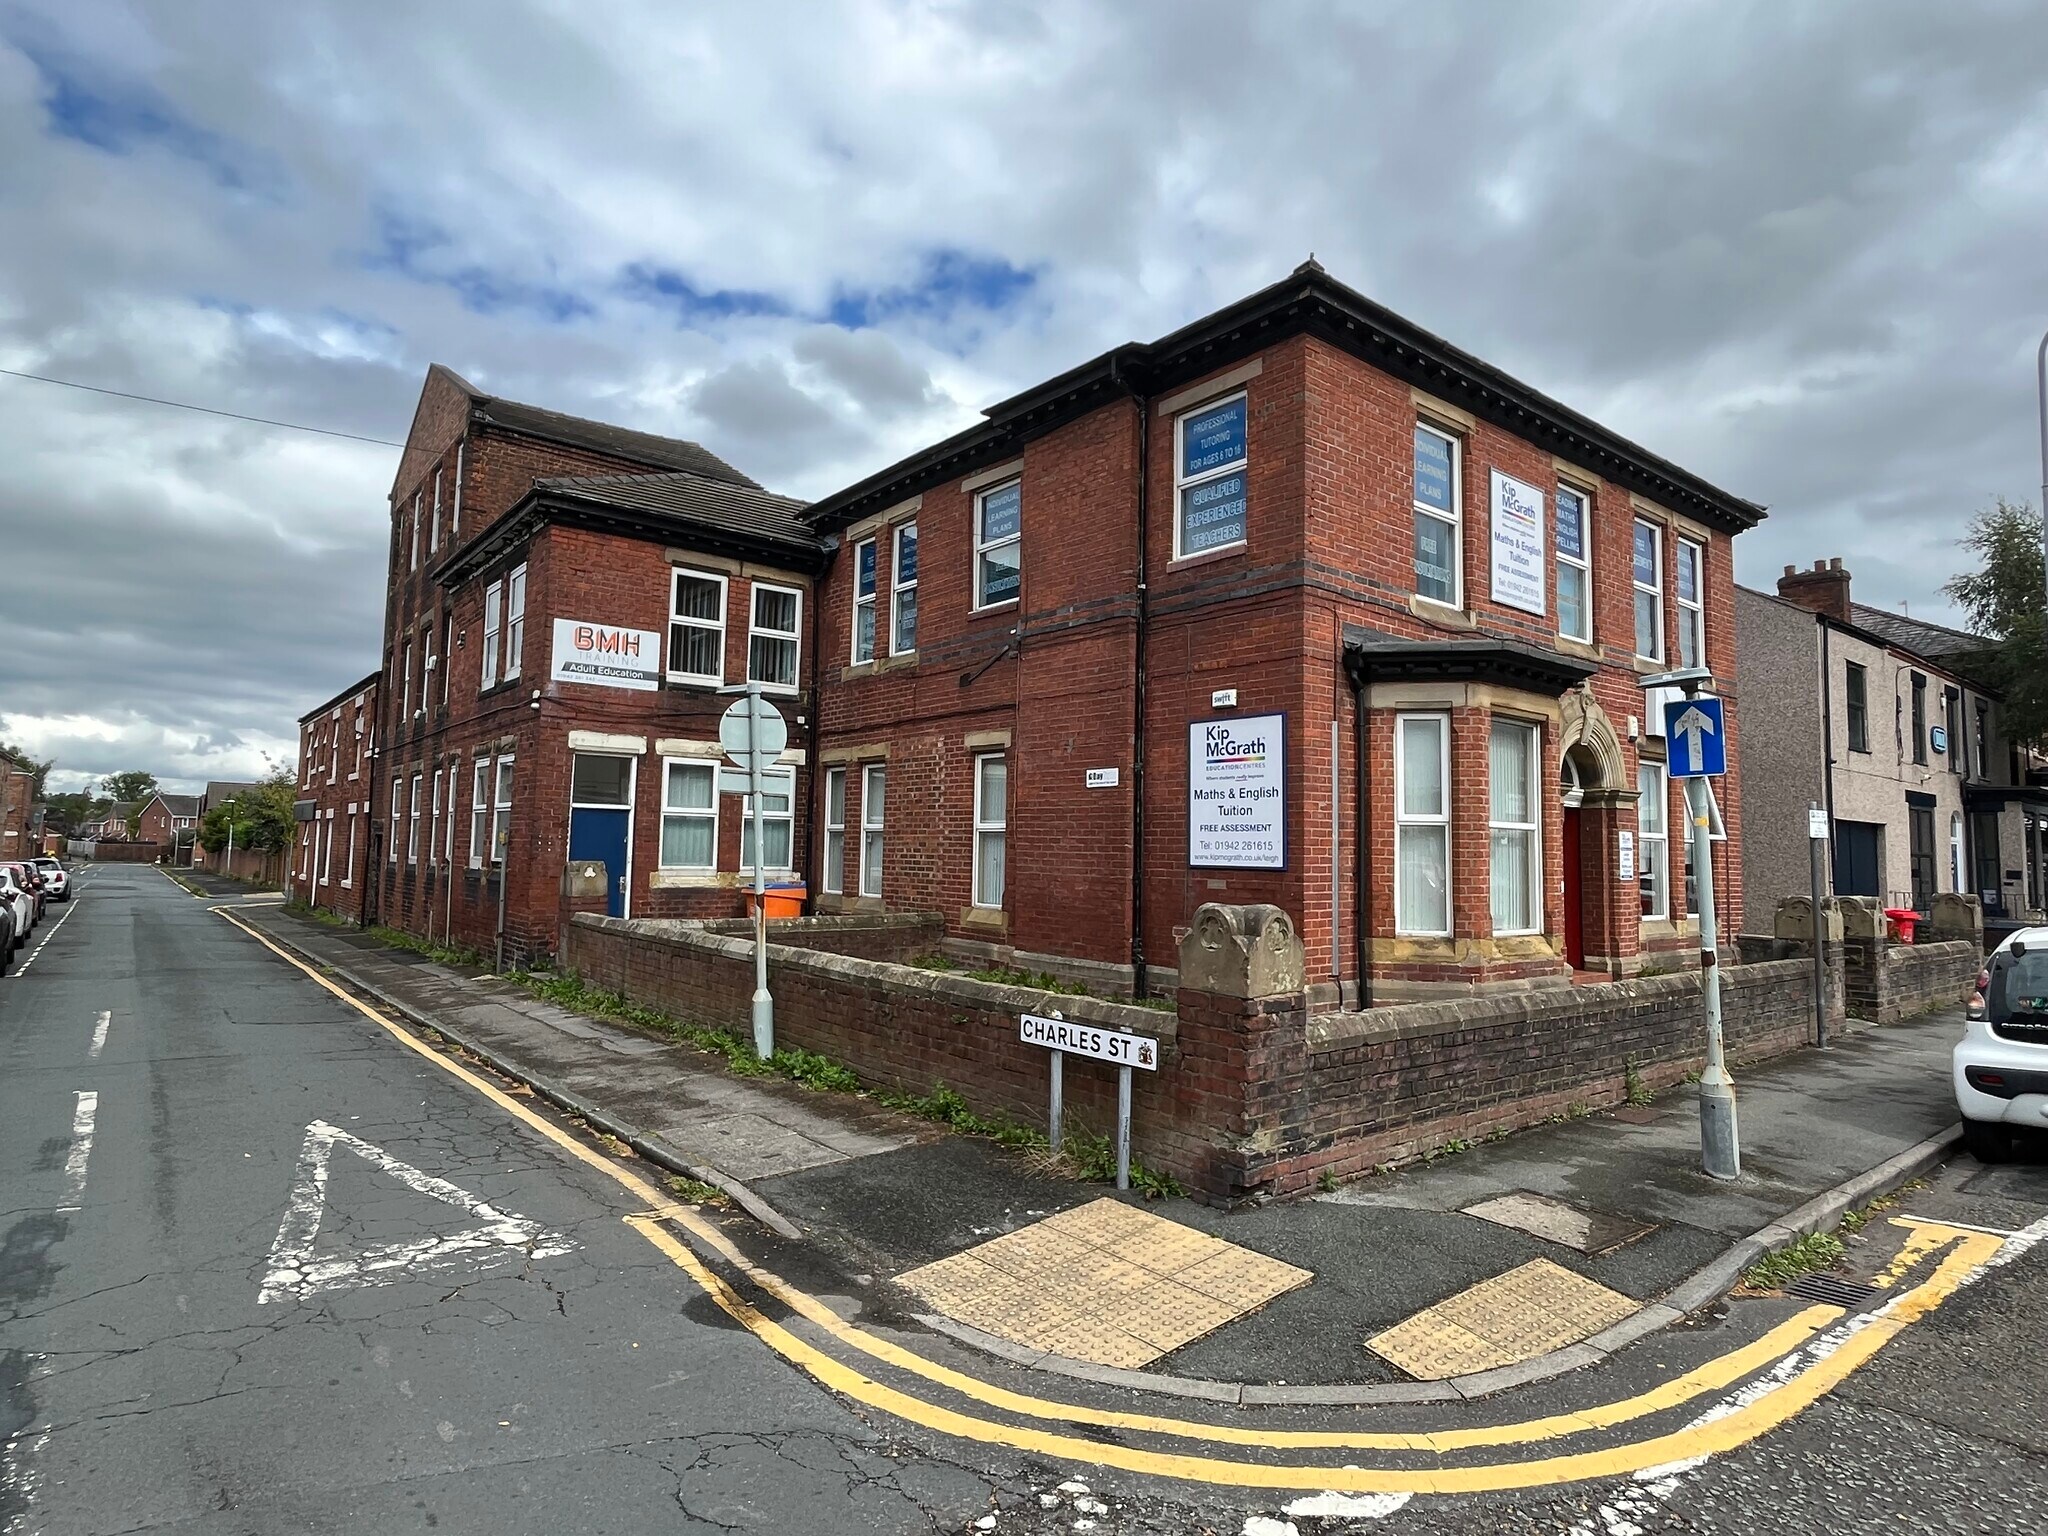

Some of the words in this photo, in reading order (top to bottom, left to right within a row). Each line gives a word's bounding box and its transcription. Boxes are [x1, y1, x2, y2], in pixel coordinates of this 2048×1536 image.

[1193, 410, 1238, 435] PROFESSIONAL
[1200, 430, 1231, 449] TUTORING
[1190, 458, 1202, 470] FOR
[1203, 451, 1219, 466] AGES
[1225, 447, 1234, 458] TO
[1192, 478, 1241, 506] QUALIFIED
[1502, 479, 1516, 501] Kip
[1185, 498, 1247, 529] EXPERIENCED
[1502, 494, 1535, 519] McGrath
[992, 521, 1013, 535] PLANS
[1191, 522, 1241, 549] TEACHERS
[1494, 531, 1515, 547] Maths
[1516, 539, 1521, 549] &
[1521, 541, 1542, 558] English
[1509, 551, 1530, 567] Tuition
[574, 626, 641, 658] BMH
[579, 652, 639, 668] TRAINING
[569, 663, 596, 674] Adult
[597, 667, 644, 679] Education
[1206, 725, 1230, 746] Kip
[1206, 737, 1266, 757] McGrath
[1194, 789, 1225, 800] Maths
[1228, 788, 1236, 799] &
[1239, 786, 1279, 801] English
[1218, 805, 1253, 816] Tuition
[1200, 824, 1219, 832] FREE
[1220, 823, 1272, 832] ASSESSMENT
[1200, 841, 1213, 850] Tel:
[1214, 841, 1240, 850] 01942
[1241, 841, 1273, 851] 261615
[1023, 1019, 1101, 1053] CHARLES
[1108, 1037, 1132, 1059] ST
